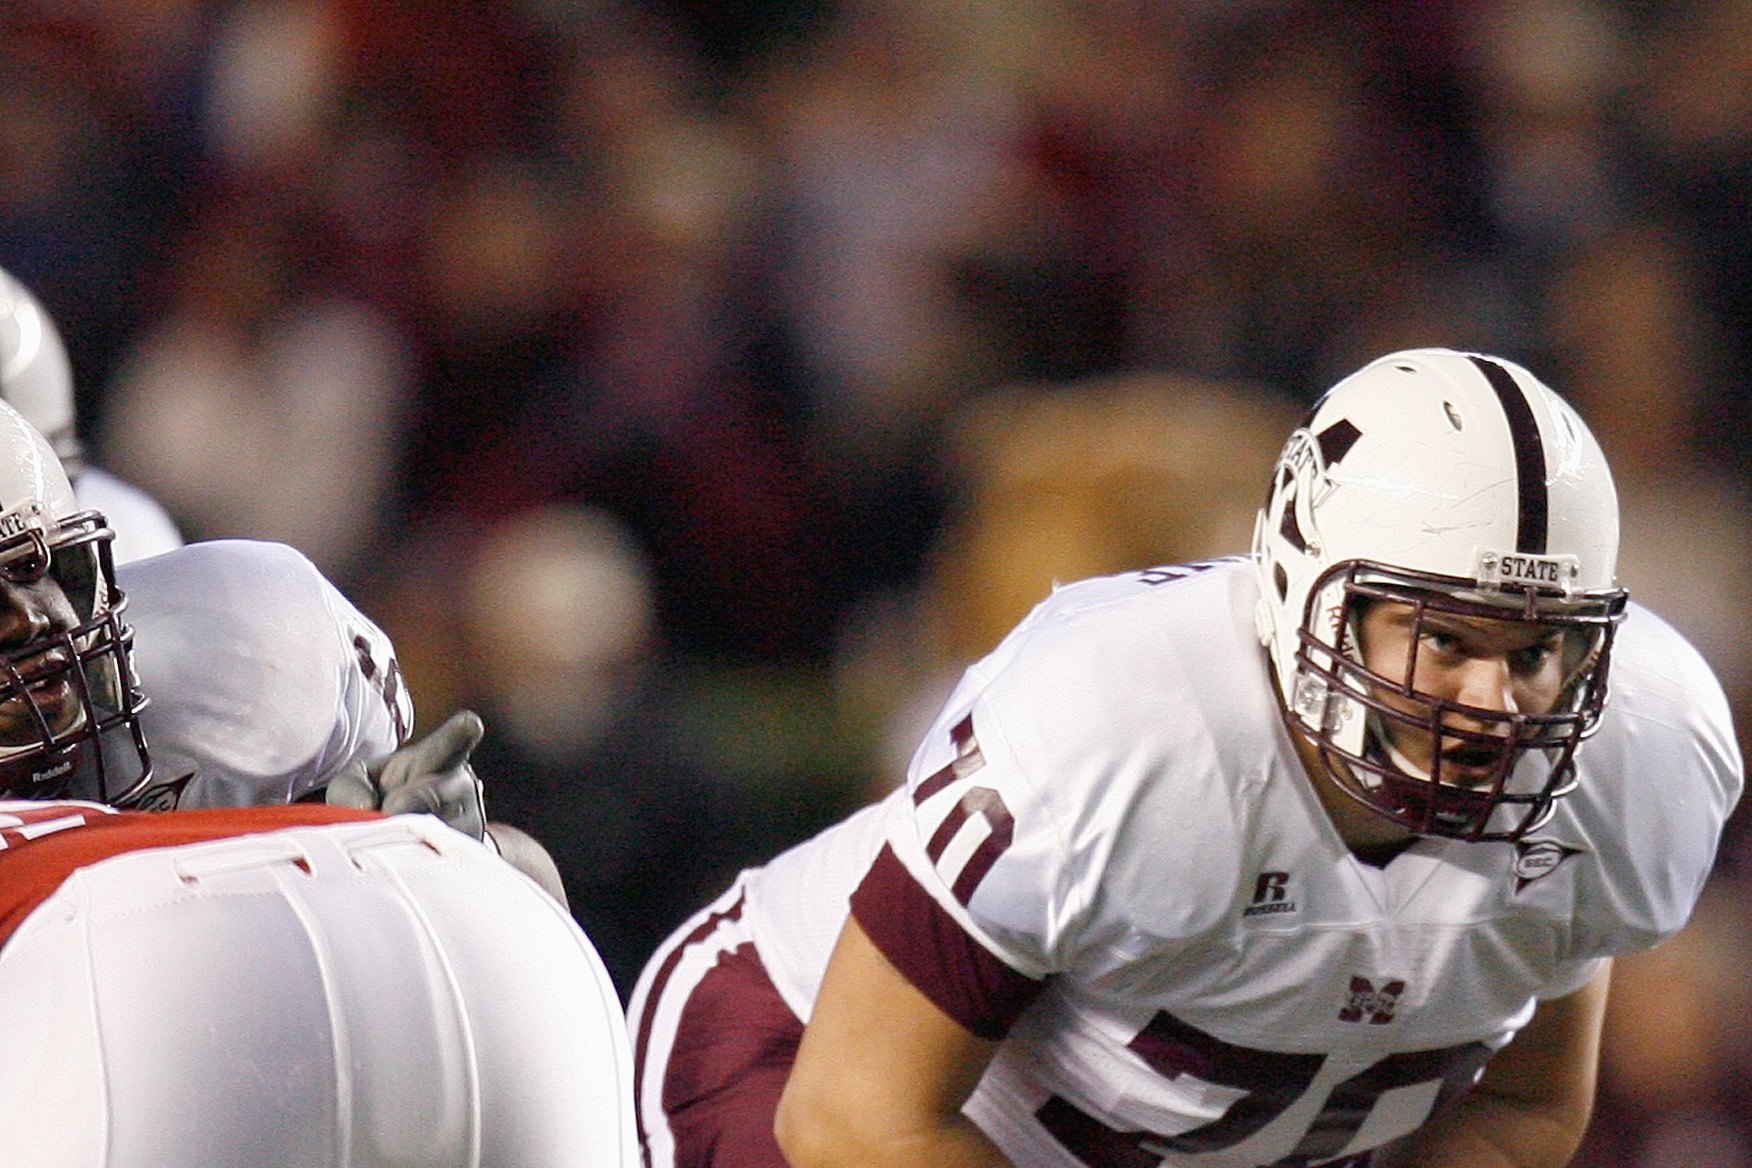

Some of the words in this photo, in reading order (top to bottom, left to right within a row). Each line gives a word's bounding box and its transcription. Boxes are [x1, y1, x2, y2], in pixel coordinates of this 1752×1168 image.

[1501, 556, 1559, 582] STATE
[32, 761, 71, 783] Riddell
[1252, 871, 1290, 904] R
